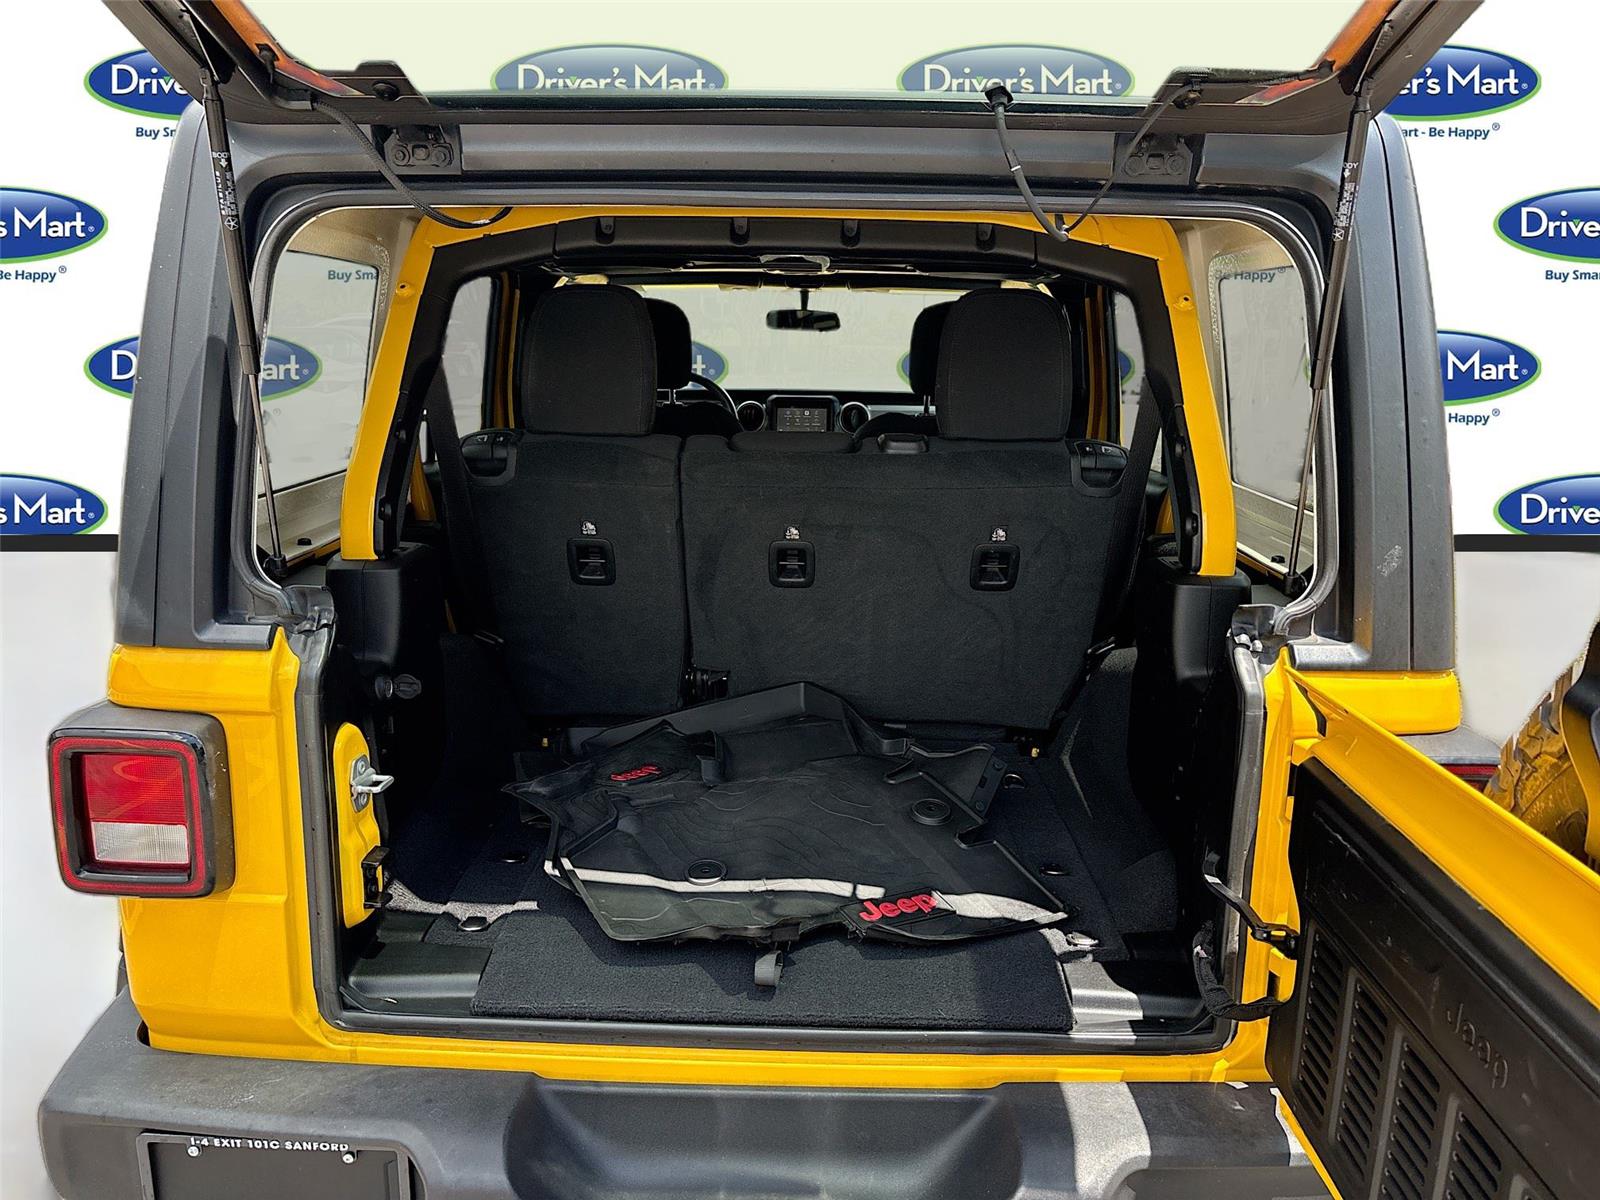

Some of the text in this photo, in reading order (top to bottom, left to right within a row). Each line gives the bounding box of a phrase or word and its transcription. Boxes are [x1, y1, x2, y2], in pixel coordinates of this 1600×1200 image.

[635, 63, 706, 90] Mart
[1041, 64, 1112, 94] Mart
[1447, 63, 1519, 95] Mart
[136, 127, 160, 140] Buy
[1429, 127, 1445, 137] Be
[1448, 127, 1490, 140] Happy
[14, 206, 86, 238] Mart
[15, 270, 57, 283] Happy
[328, 270, 352, 283] Buy
[1545, 270, 1569, 283] Buy
[1447, 349, 1519, 381] Mart
[1448, 413, 1490, 426] Happy
[14, 492, 86, 525] Mart
[859, 894, 938, 922] Jeep
[190, 1136, 349, 1151] I-4 EXIT 101C SANFORD
